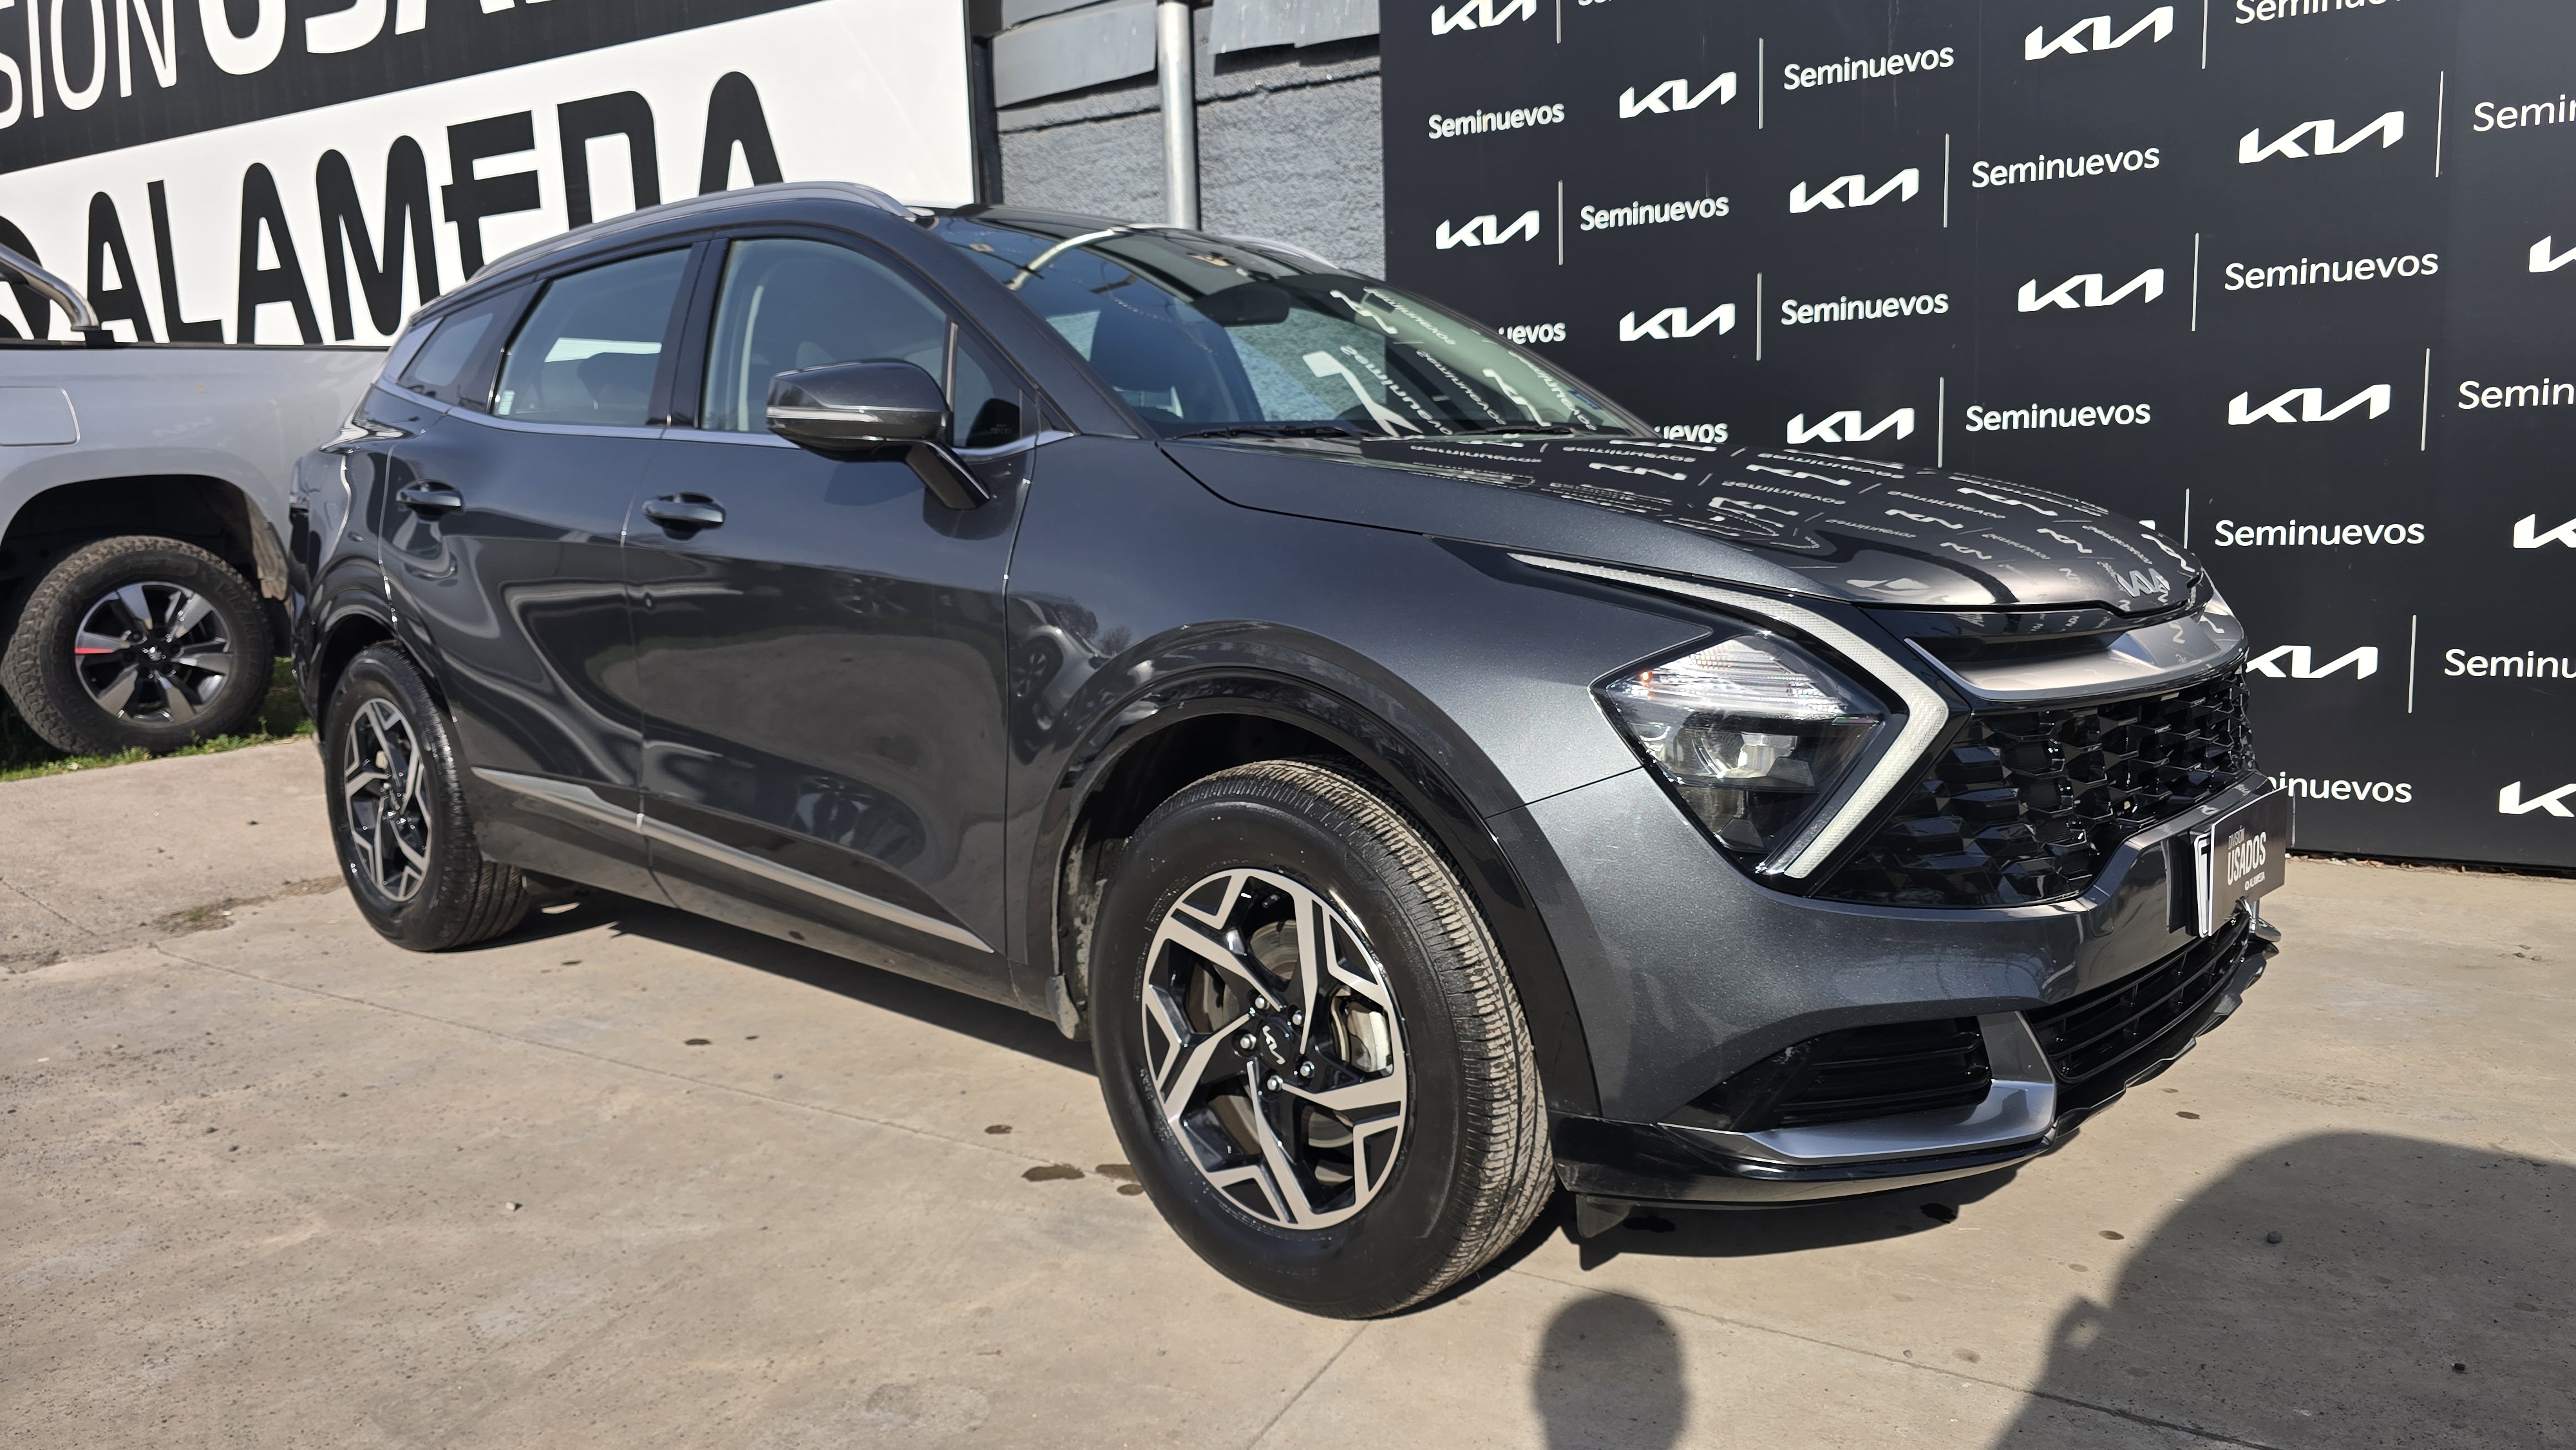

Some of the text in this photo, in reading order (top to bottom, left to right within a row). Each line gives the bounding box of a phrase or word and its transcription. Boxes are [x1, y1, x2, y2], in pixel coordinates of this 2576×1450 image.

[2025, 6, 2174, 61] KIA
[1620, 47, 1954, 118] KIA Seminuevos
[1429, 104, 1564, 138] Seminuevos
[2239, 94, 2576, 164] KIA Semi
[1790, 148, 2159, 213] KIA Seminuevos
[1436, 197, 1729, 249] KIA Seminuevos
[2018, 254, 2438, 312] KIA Seminuevos
[1620, 294, 1948, 341] KIA Seminuevos
[1787, 404, 2150, 444] KIA Seminuevos
[2228, 384, 2391, 425] KIA
[2215, 520, 2424, 546] Seminuevos
[2228, 832, 2266, 885] USADOS
